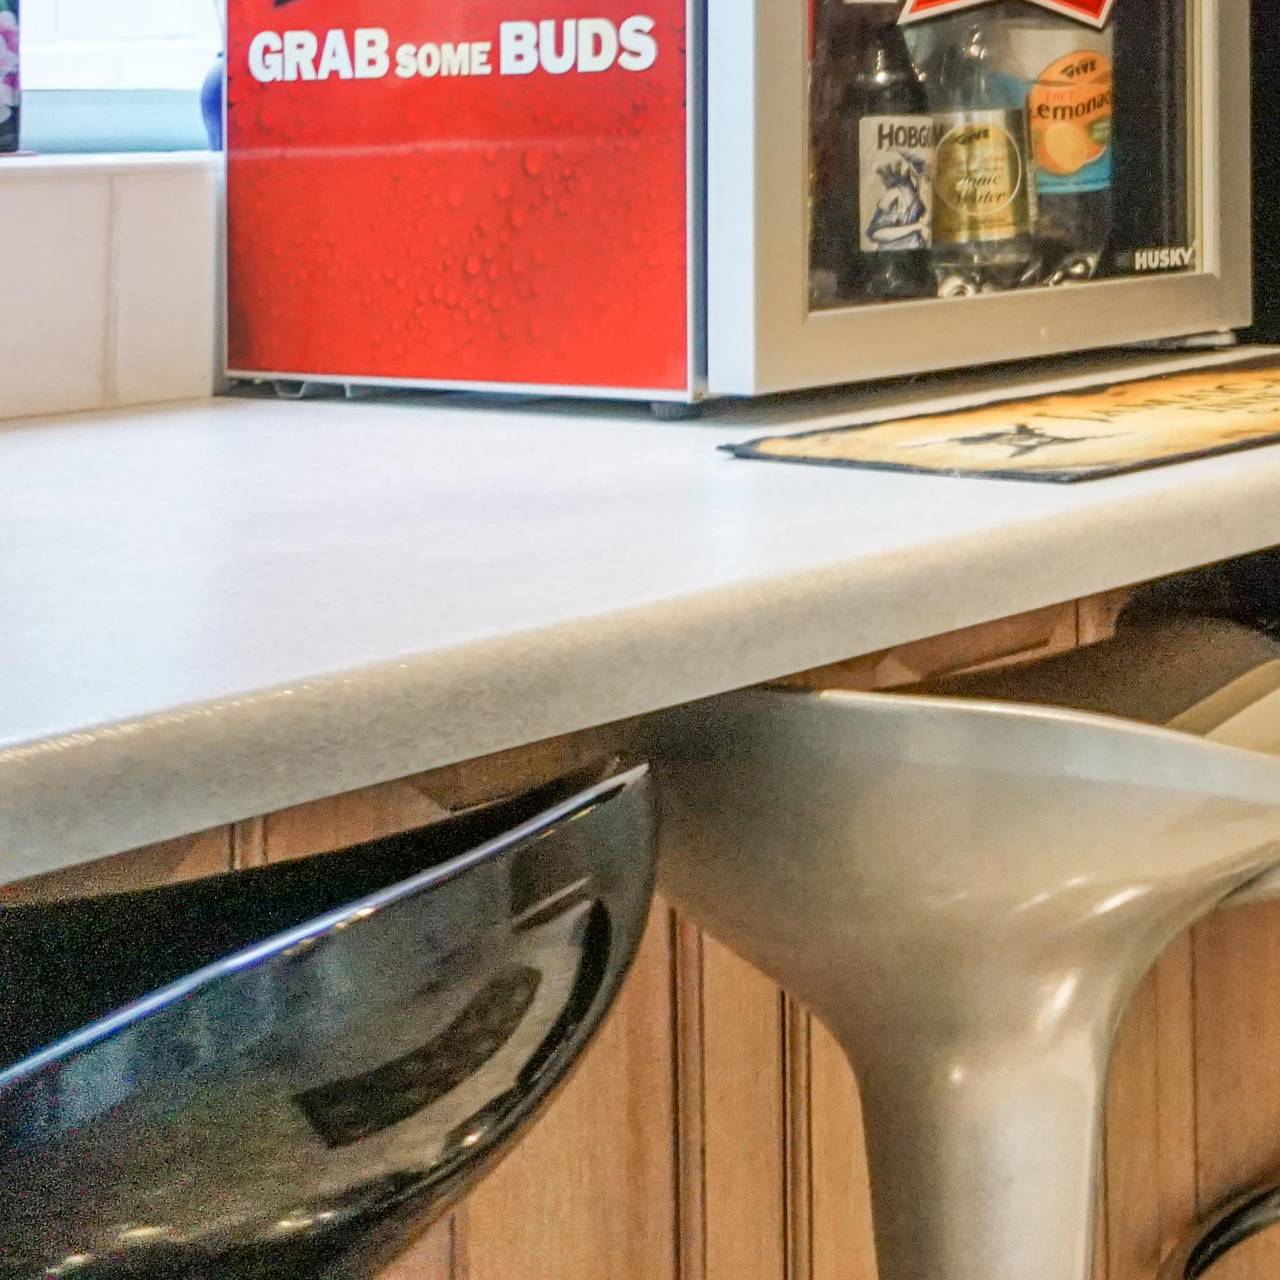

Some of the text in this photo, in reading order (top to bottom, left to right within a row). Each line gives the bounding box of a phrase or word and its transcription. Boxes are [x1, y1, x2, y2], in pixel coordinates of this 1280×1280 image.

[247, 14, 658, 83] GRAB SOME BUDS
[1135, 246, 1194, 271] HUSKY
